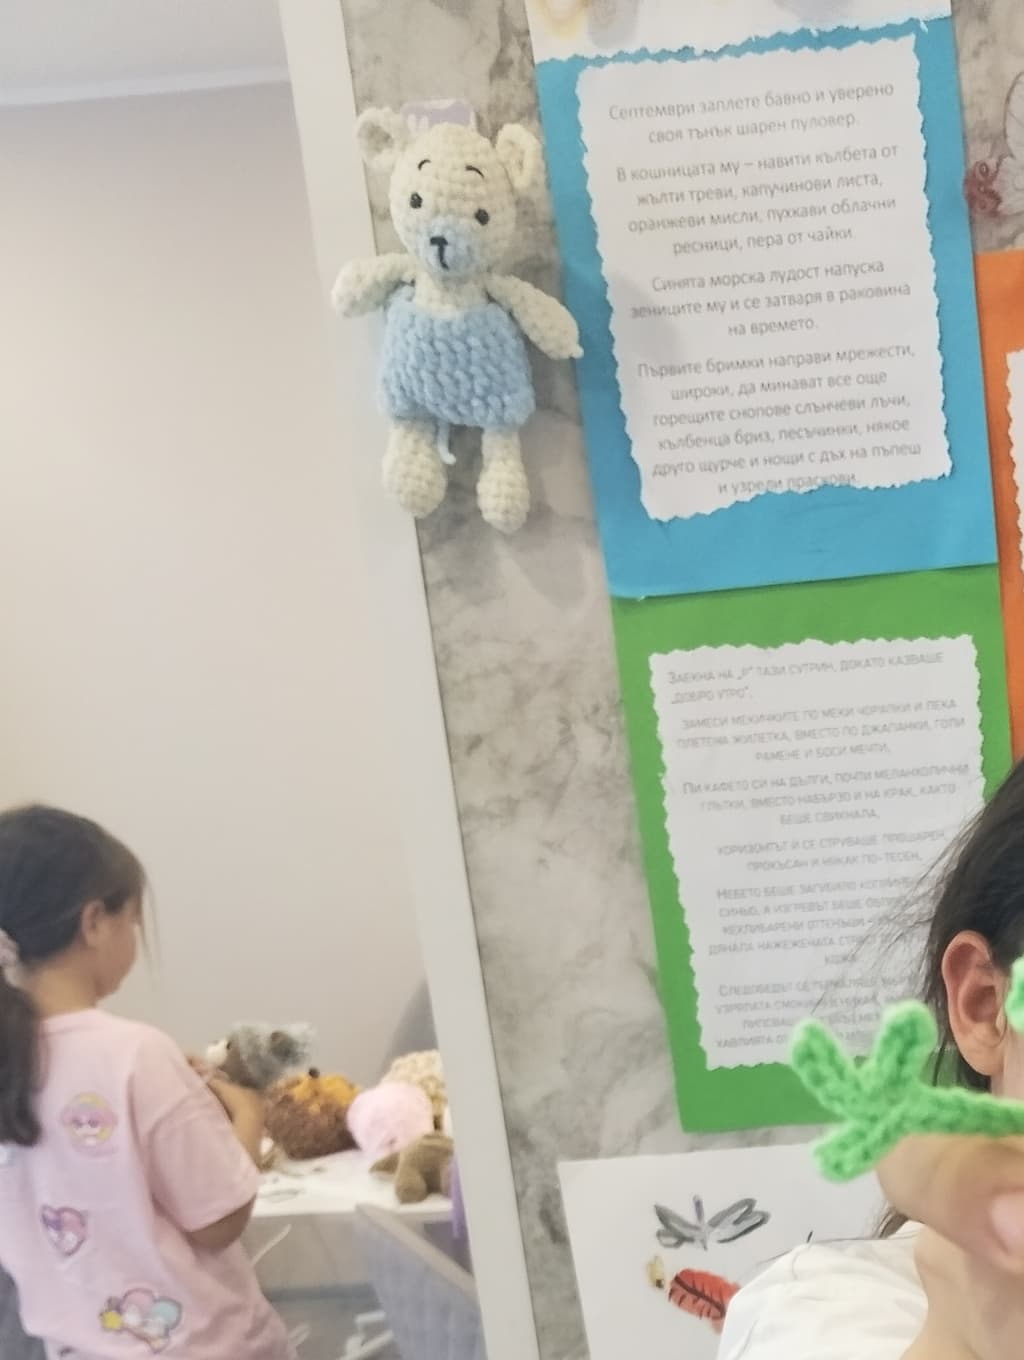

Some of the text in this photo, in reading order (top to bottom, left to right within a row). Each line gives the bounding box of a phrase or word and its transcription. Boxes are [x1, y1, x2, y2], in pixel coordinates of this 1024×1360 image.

[608, 83, 894, 121] Септември заплете бавно и уверено
[647, 129, 684, 143] своя
[687, 124, 732, 140] тънък
[735, 119, 787, 137] шарен
[615, 145, 897, 182] В кошницата му навити кълбета от
[636, 190, 685, 205] жълти
[627, 214, 706, 236] оранжеви
[766, 204, 827, 224] пухкави
[830, 197, 896, 215] облачни
[745, 233, 784, 250] пера
[786, 232, 803, 244] от
[651, 260, 884, 292] Синята морска лудост напуска
[630, 284, 911, 320] зениците му и се затваря в раковина
[727, 323, 746, 336] на
[636, 362, 702, 381] Първите
[705, 356, 765, 376] бримки
[767, 351, 832, 370] направи
[736, 382, 756, 399] да
[759, 377, 823, 393] минават
[826, 374, 852, 388] все
[855, 371, 887, 388] още
[652, 409, 726, 429] горещите
[728, 404, 792, 420] снопове
[793, 397, 866, 415] слънчеви
[657, 432, 731, 451] кълбенца
[865, 419, 910, 434] някое
[651, 442, 921, 481] друго щурче и нощи с дъх на пъпеш
[716, 482, 728, 494] и
